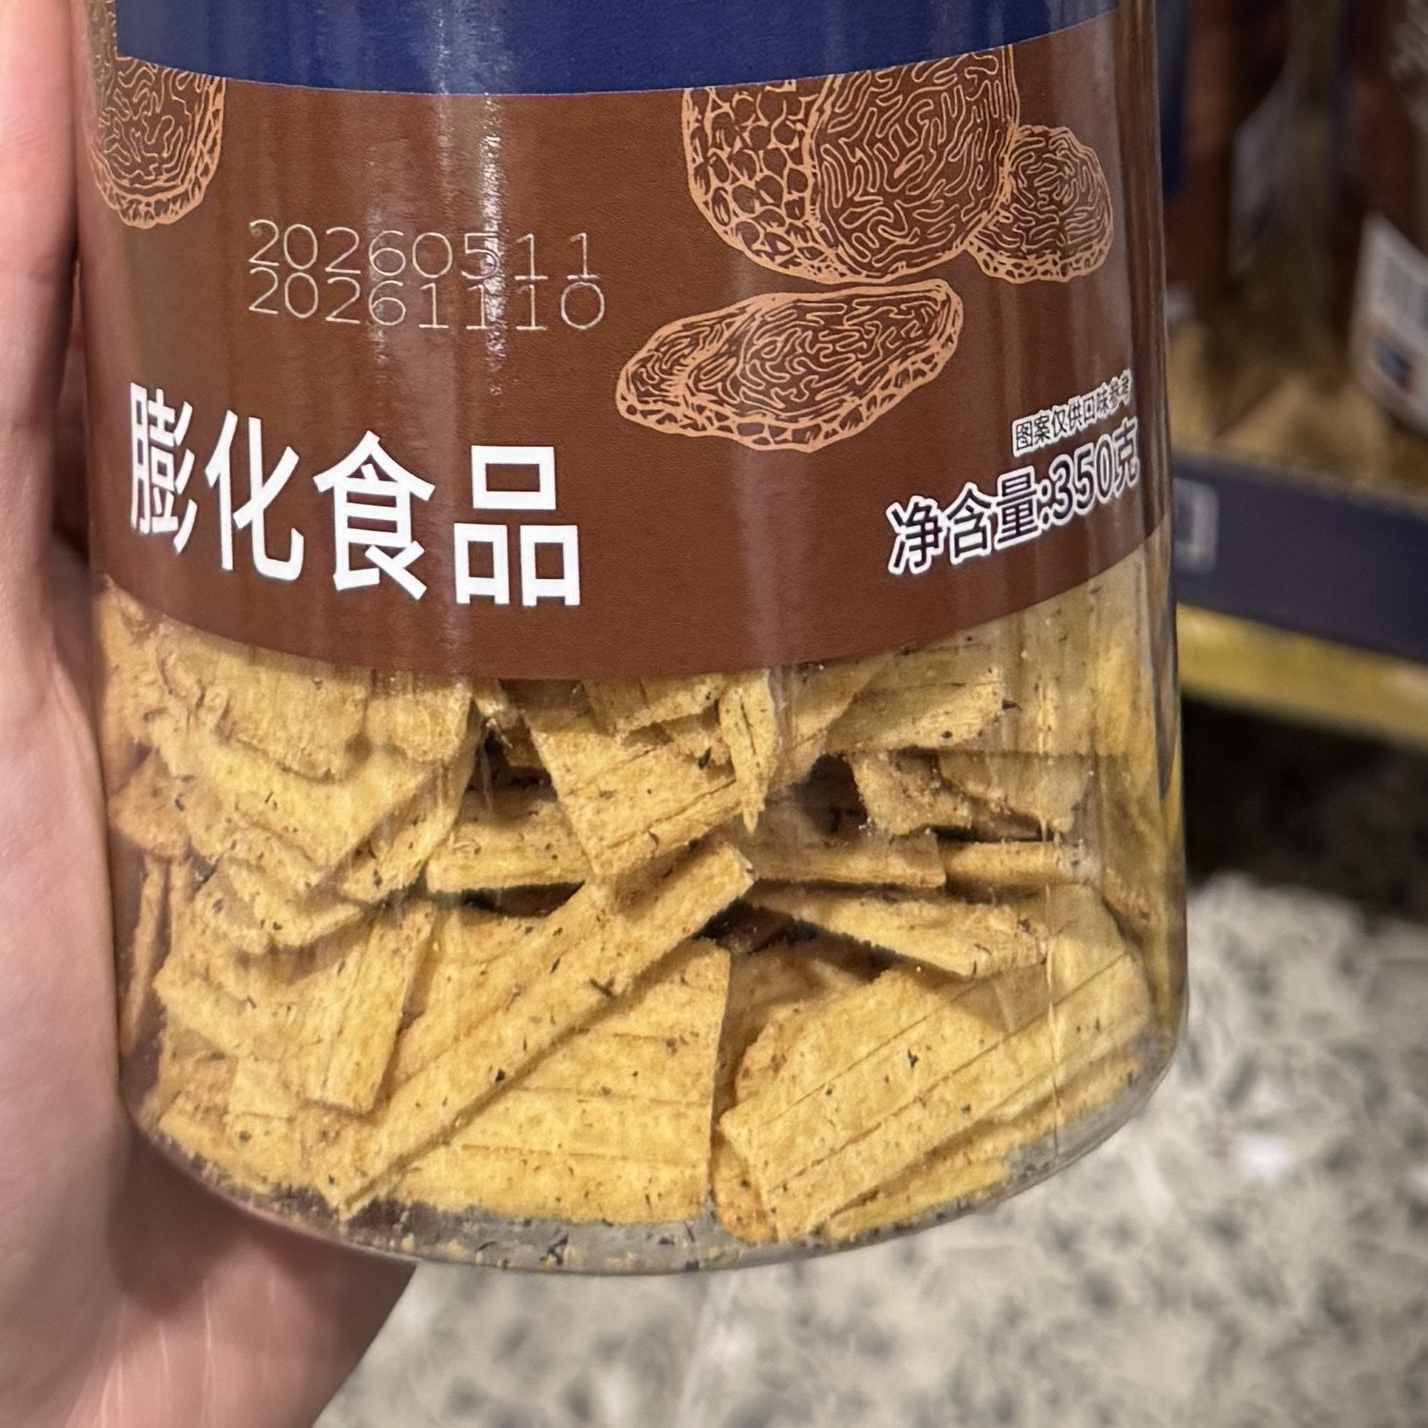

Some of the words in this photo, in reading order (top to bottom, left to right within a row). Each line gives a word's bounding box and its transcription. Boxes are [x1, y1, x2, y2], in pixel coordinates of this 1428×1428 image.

[248, 218, 600, 281] 20260511
[248, 266, 605, 331] 20261110
[130, 382, 581, 607] 膨化食品
